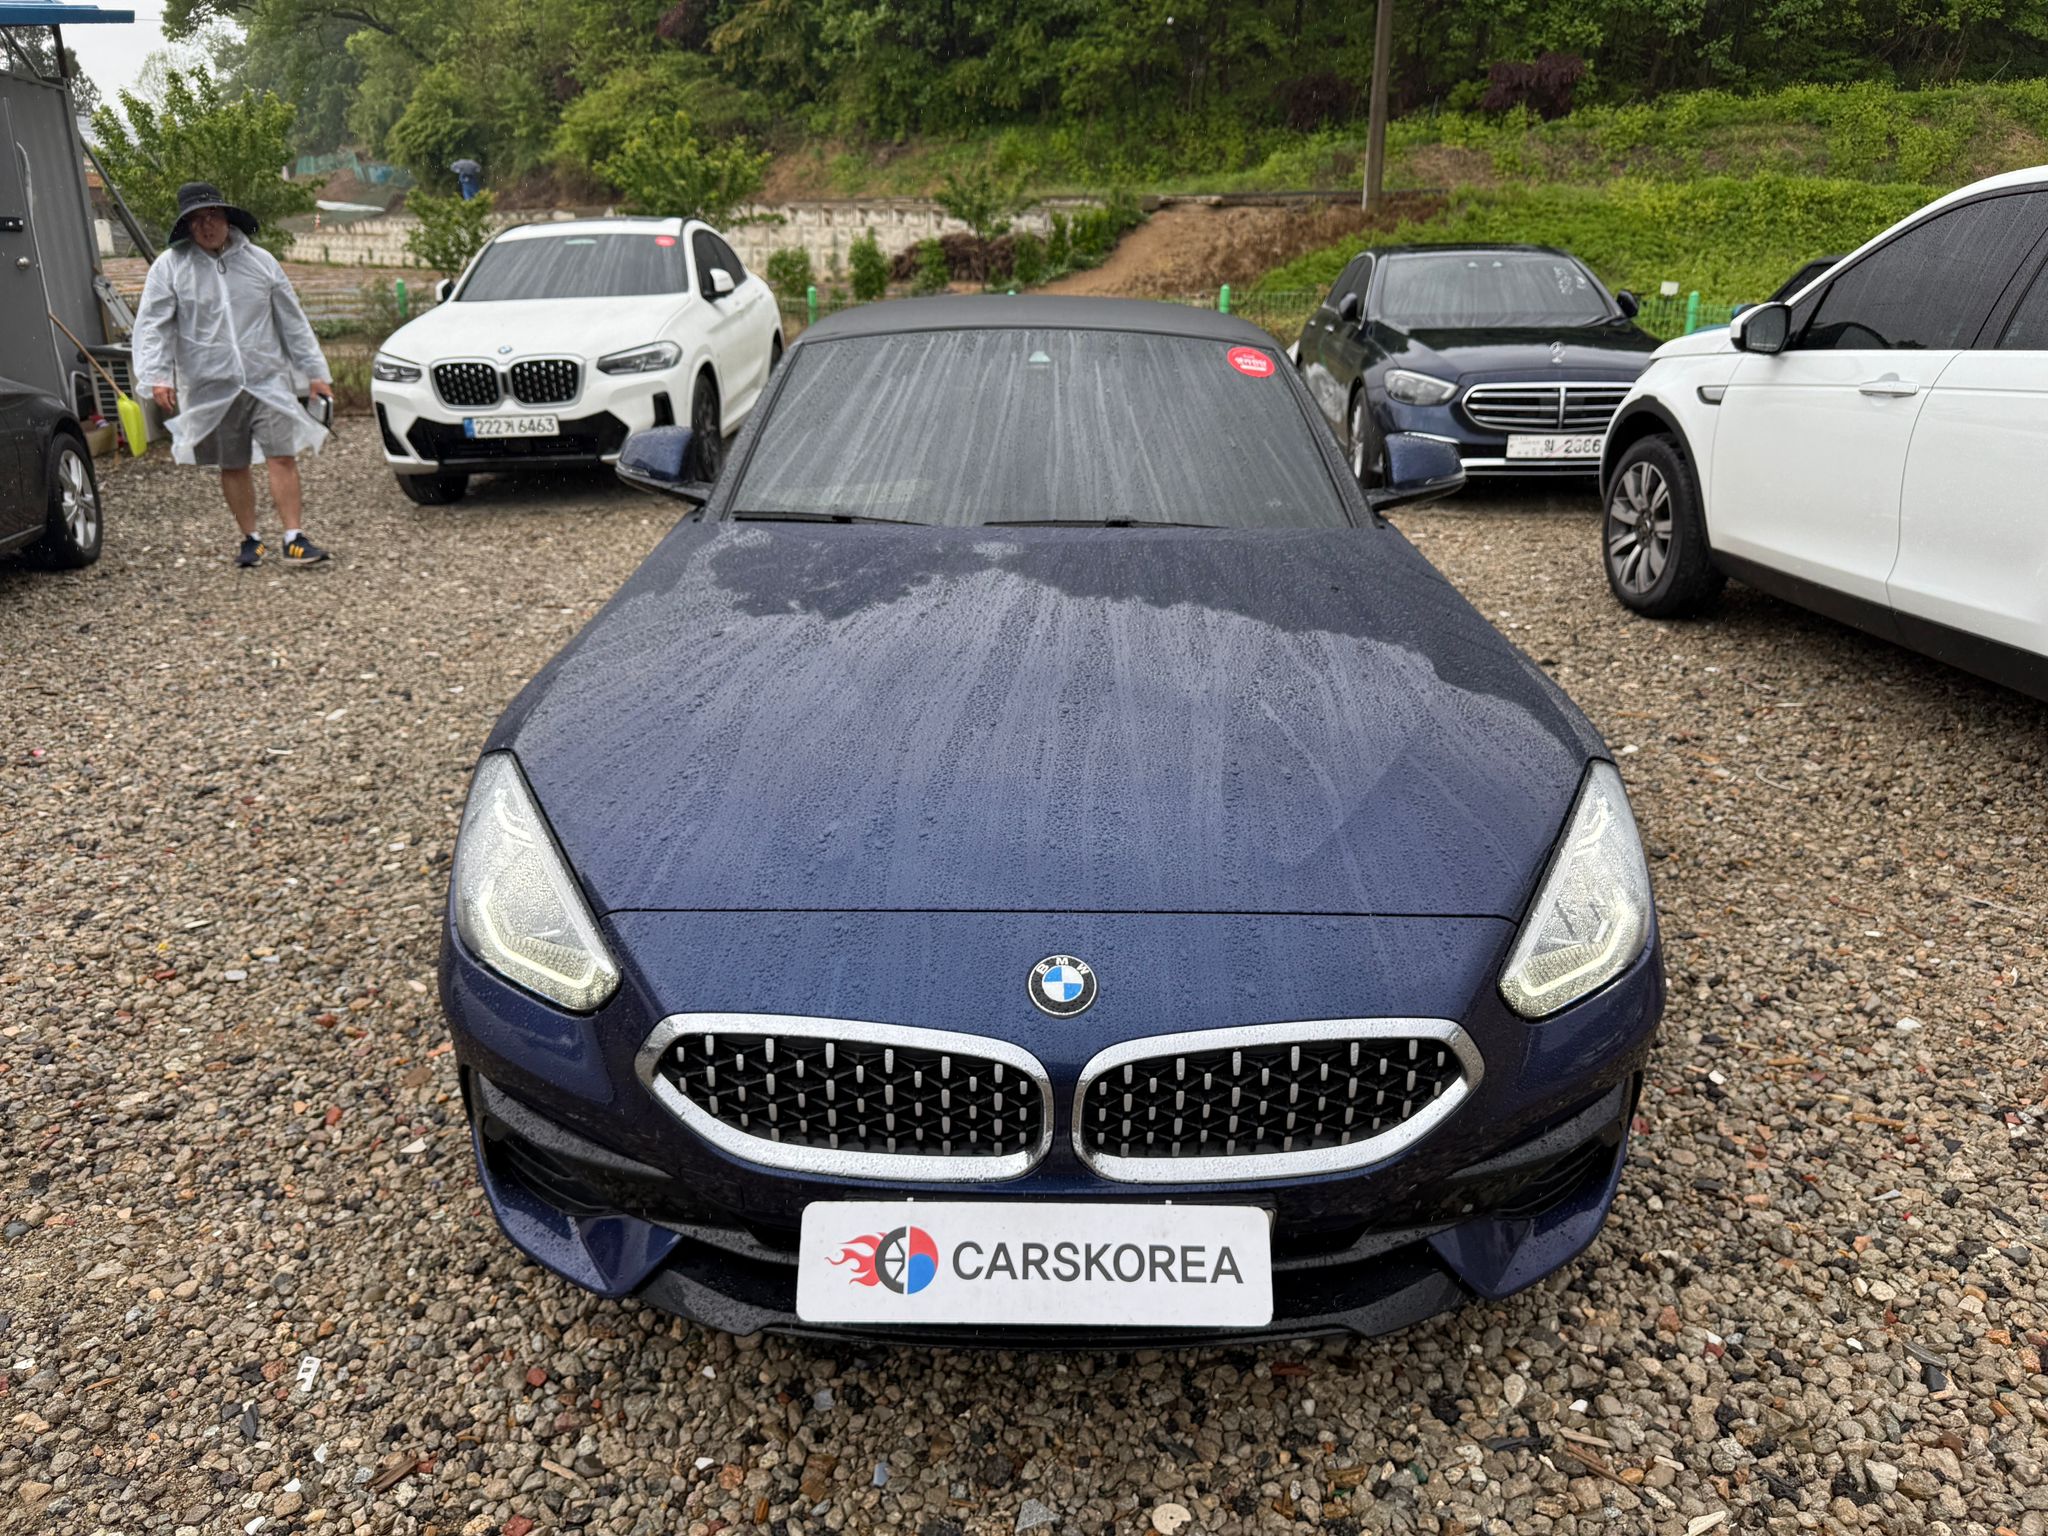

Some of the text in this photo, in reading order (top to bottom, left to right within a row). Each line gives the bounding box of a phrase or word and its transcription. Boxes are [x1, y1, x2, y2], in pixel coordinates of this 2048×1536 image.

[518, 417, 555, 433] 6463
[1035, 957, 1090, 975] BMW
[952, 1240, 1244, 1284] CARSKOREA
